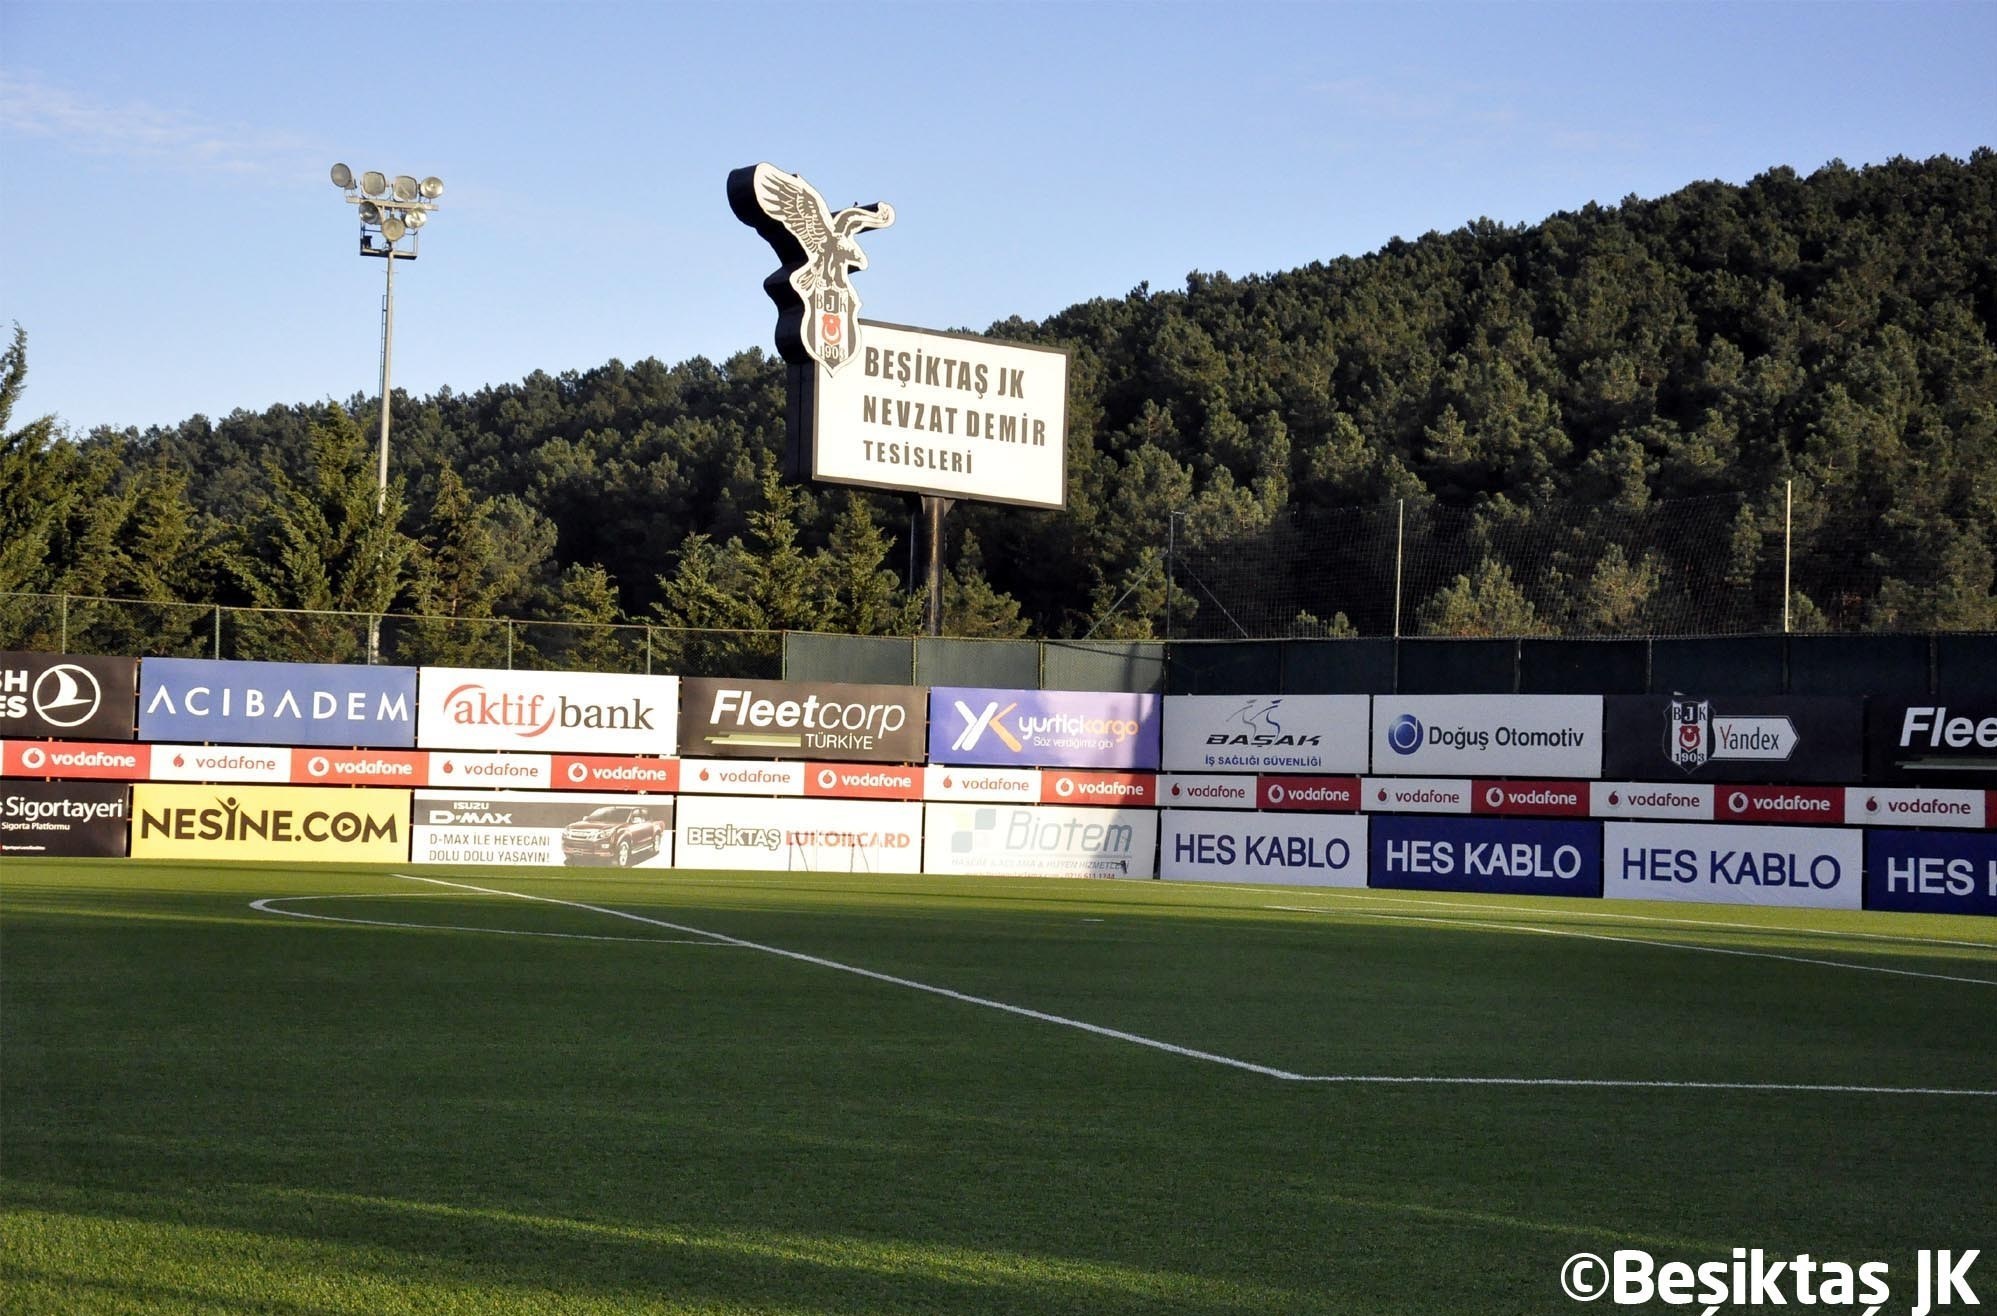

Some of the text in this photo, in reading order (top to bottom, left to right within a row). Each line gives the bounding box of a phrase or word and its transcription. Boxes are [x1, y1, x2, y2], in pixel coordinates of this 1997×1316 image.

[864, 346, 1025, 399] BEŞİKTAŞ JK
[863, 395, 1046, 446] NEVZAT DEMİR
[863, 440, 973, 474] TESİSLERİ
[147, 684, 409, 722] ACIBADEM
[453, 692, 655, 730] aktif bank
[709, 689, 906, 740] Fleetcorp
[1673, 706, 1706, 721] BJK
[805, 731, 873, 750] TÜRKİYE
[1206, 734, 1323, 748] BAŞAK
[1428, 726, 1584, 751] Doğuş Otomotiv
[1719, 723, 1780, 751] Yandex
[51, 751, 136, 767] vodafone
[196, 755, 276, 770] vodafone
[1205, 754, 1322, 768] İŞ SAĞLIĞI GÜVENLİĞİ
[1674, 752, 1706, 763] 1903
[334, 759, 413, 775] vodafone
[464, 762, 538, 778] vodafone
[592, 766, 667, 782] vodafone
[720, 770, 791, 784] vodafone
[841, 773, 912, 788] vodafone
[962, 776, 1030, 791] vodafone
[1078, 780, 1144, 796] vodafone
[1187, 784, 1246, 799] vodafone
[1288, 787, 1350, 801] vodafone
[1395, 790, 1460, 804] vodafone
[1508, 790, 1577, 805] vodafone
[1627, 792, 1700, 808] vodafone
[1753, 795, 1831, 811] vodafone
[5, 796, 123, 823] Sigortayeri
[453, 801, 490, 810] ISUZU
[1888, 798, 1971, 815] vodafone
[1, 822, 71, 831] Sigorta Platformu
[1005, 809, 1133, 852] Biotem
[429, 832, 550, 847] D-MAX İLE HEYECANI
[687, 824, 782, 851] BEŞİKTAŞ
[429, 850, 460, 861] DOLU
[464, 850, 495, 862] DOLU
[1175, 832, 1350, 870] HES KABLO
[1386, 839, 1582, 879] HES KABLO
[1622, 847, 1841, 890] HES KABLO
[1887, 856, 1975, 896] HES
